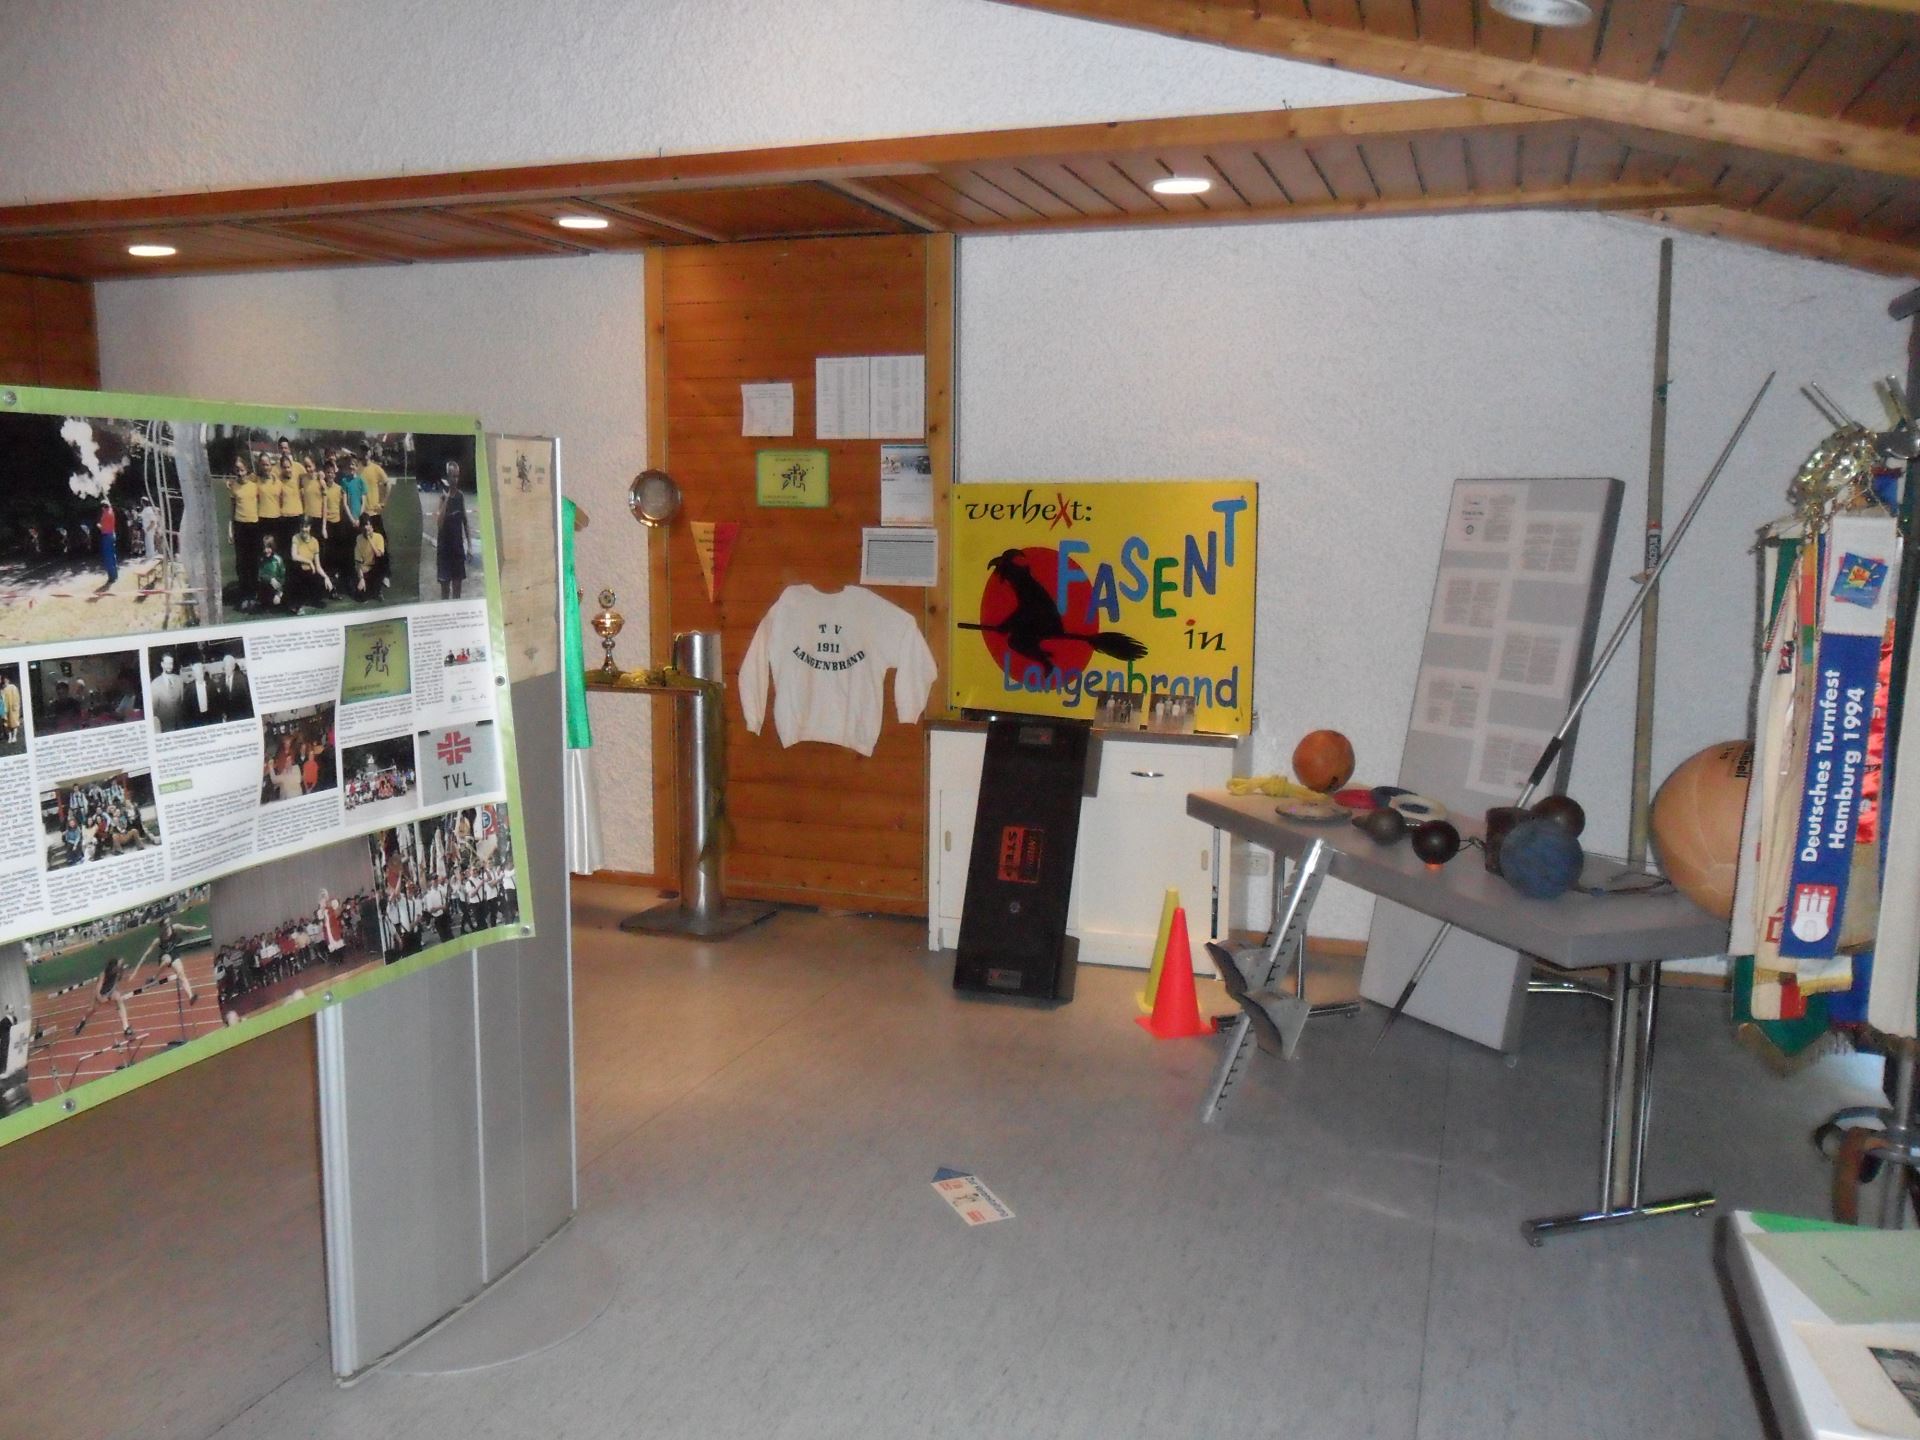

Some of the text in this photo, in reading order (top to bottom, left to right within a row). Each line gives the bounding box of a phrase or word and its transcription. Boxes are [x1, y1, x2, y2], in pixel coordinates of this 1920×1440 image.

[816, 641, 840, 654] 1911
[1183, 619, 1227, 652] in
[792, 645, 866, 671] LANGENBRAND
[1003, 651, 1239, 709] Langenbrand
[442, 771, 473, 792] TVL
[1801, 669, 1841, 863] Deutsches Turnfest
[1828, 687, 1866, 849] Hamburg 1994
